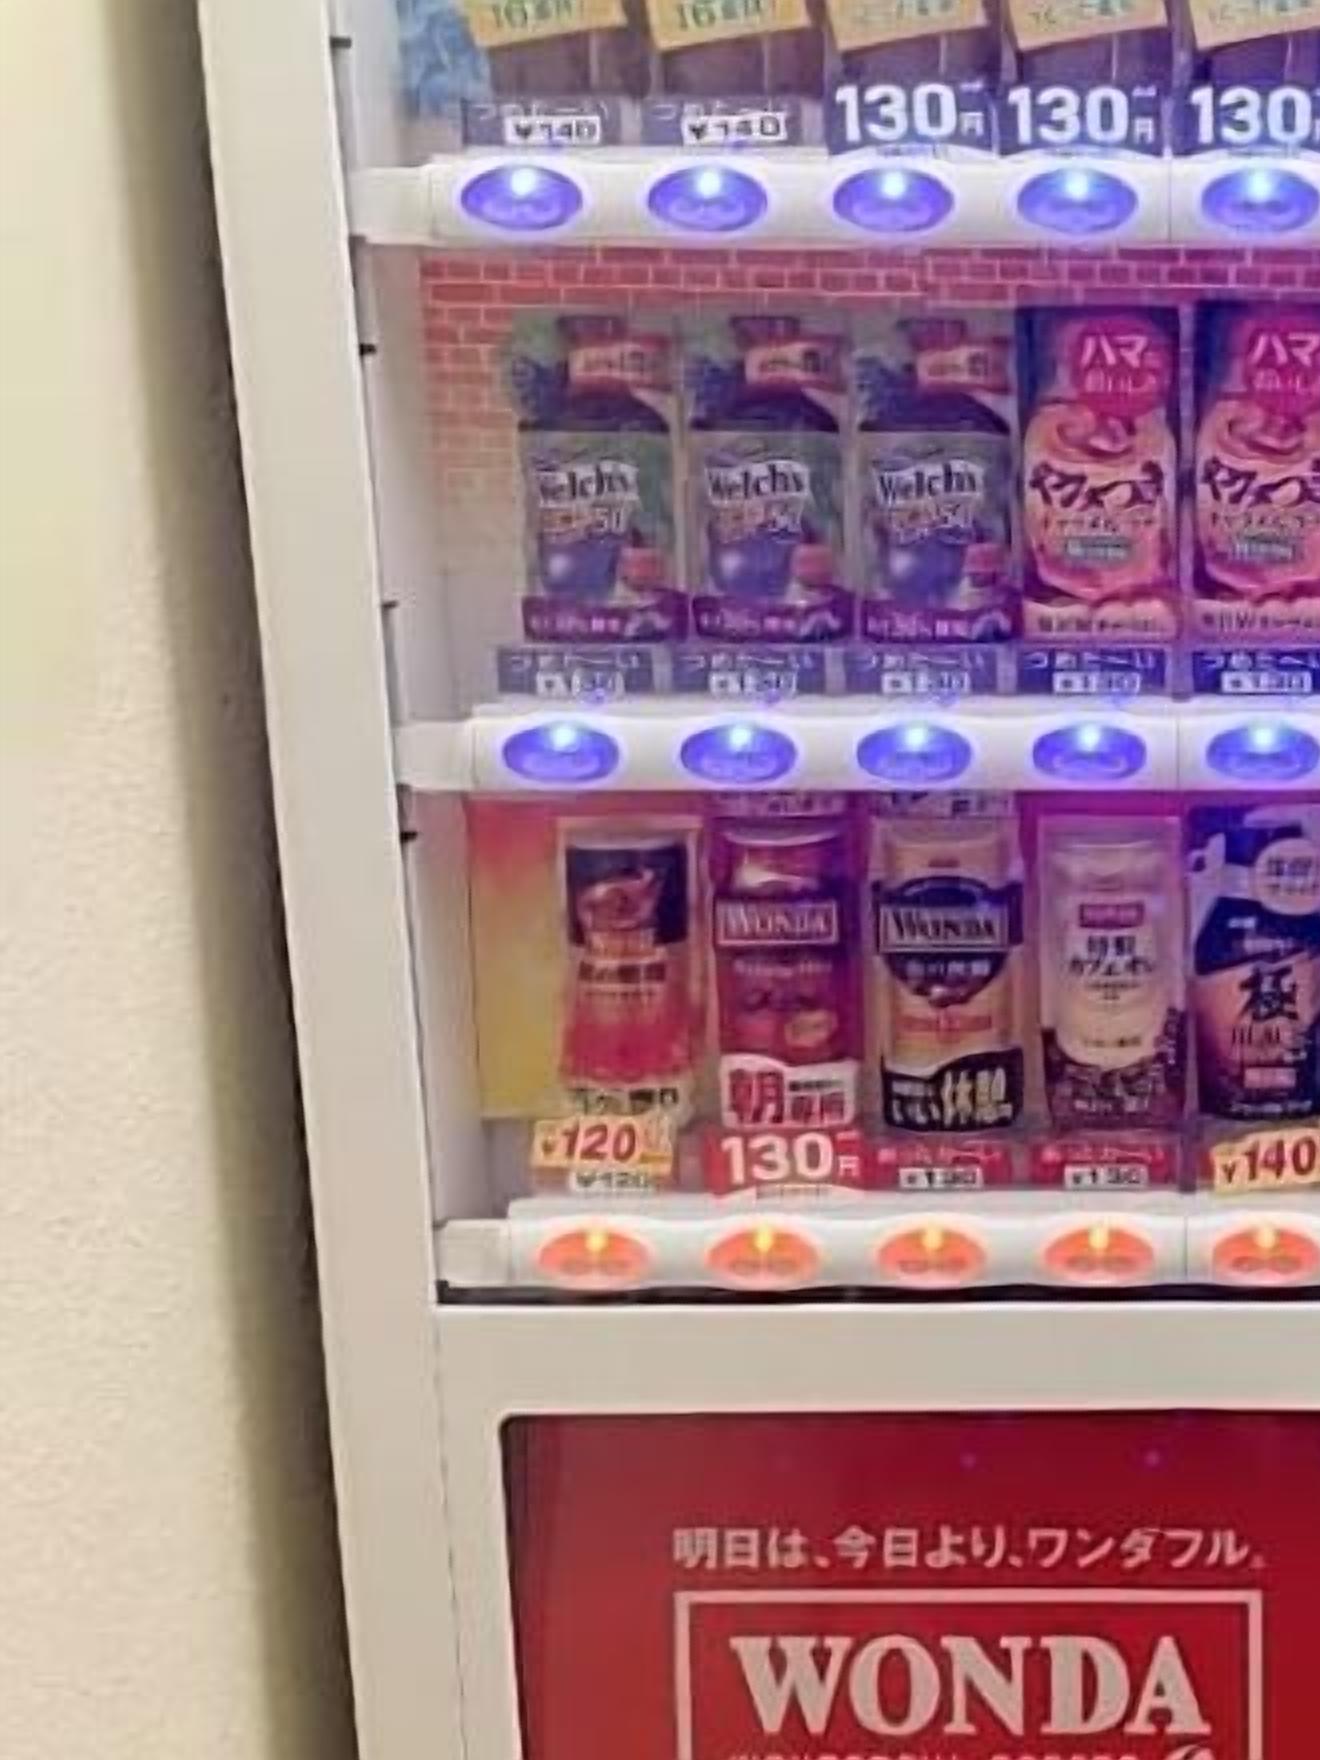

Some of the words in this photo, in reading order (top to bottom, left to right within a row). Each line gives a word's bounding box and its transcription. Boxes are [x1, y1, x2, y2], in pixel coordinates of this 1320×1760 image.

[893, 908, 996, 941] WONDA
[538, 1122, 639, 1167] ¥120
[1220, 1140, 1318, 1185] ¥140
[671, 1525, 1268, 1570] 明日は、今日より、ワンダフル。
[728, 1634, 1213, 1736] WONDA
